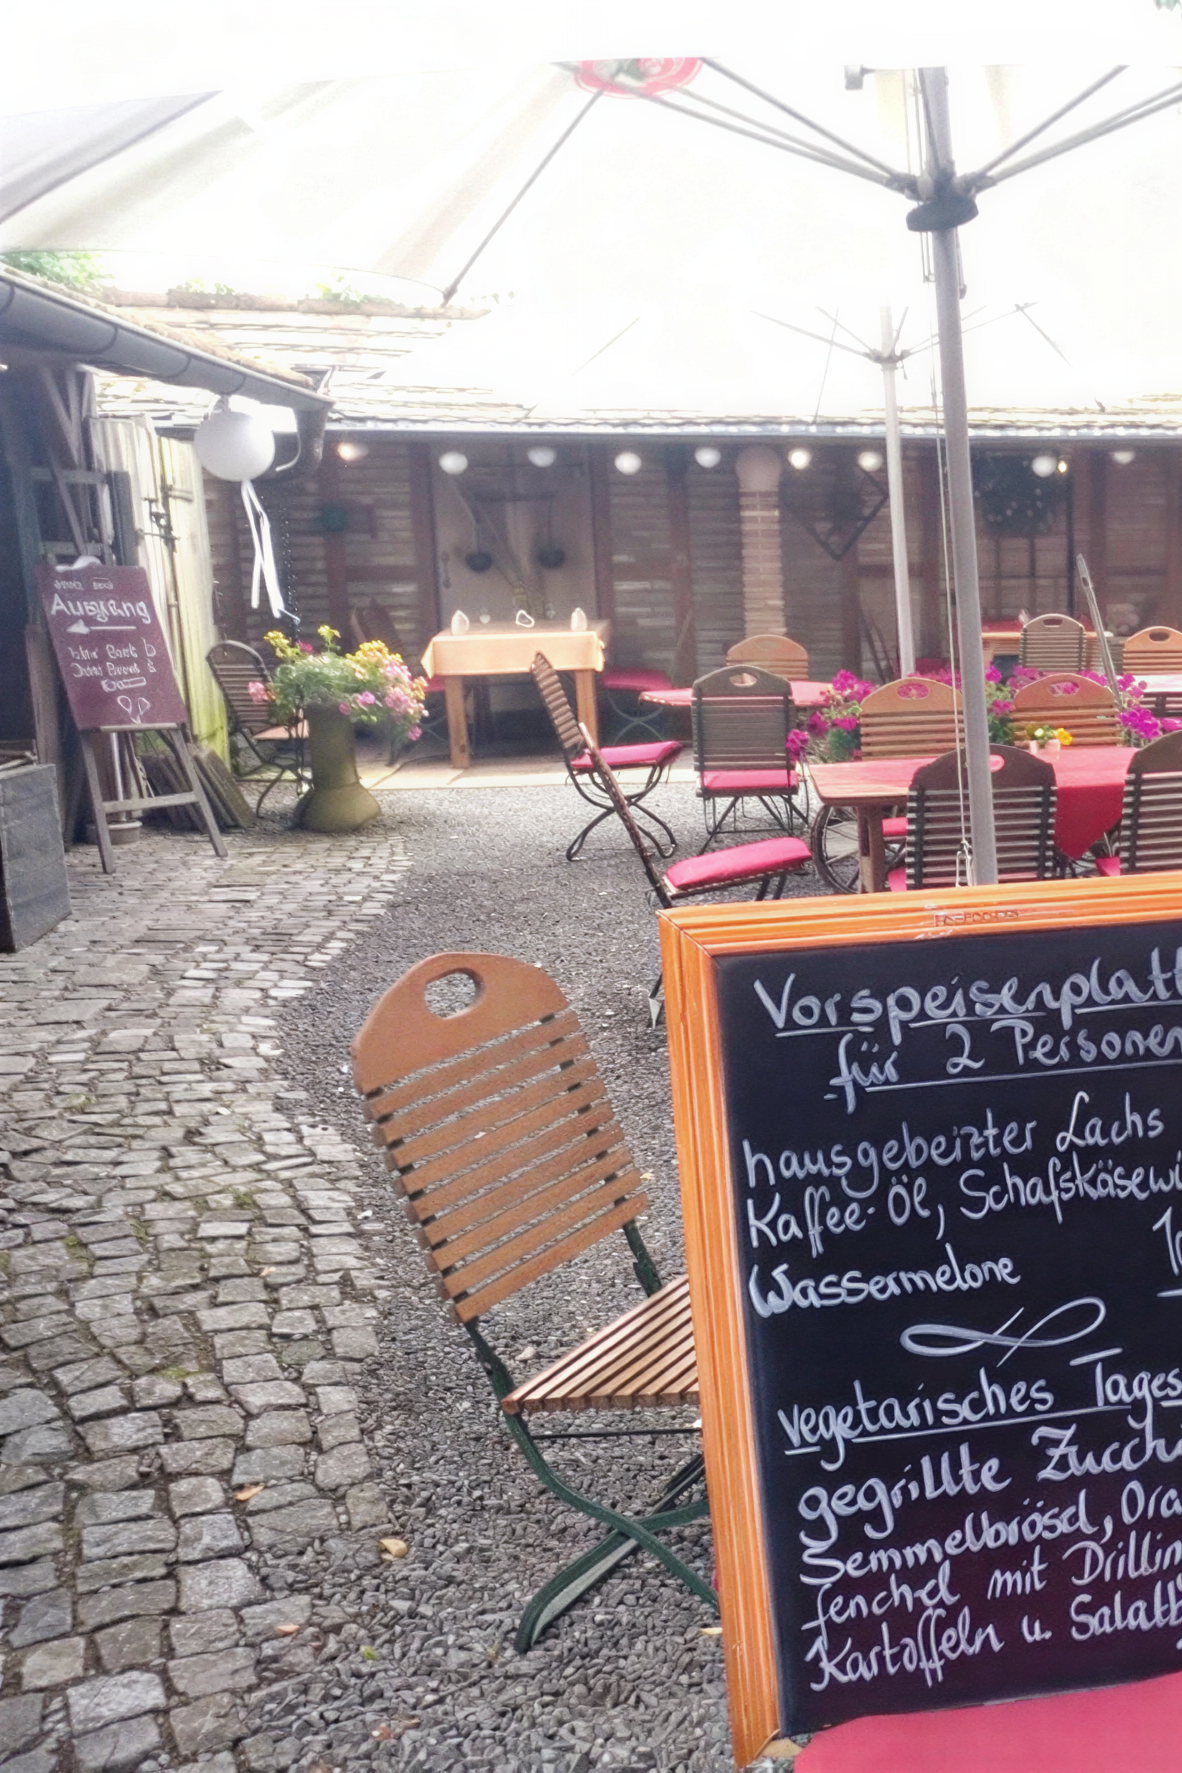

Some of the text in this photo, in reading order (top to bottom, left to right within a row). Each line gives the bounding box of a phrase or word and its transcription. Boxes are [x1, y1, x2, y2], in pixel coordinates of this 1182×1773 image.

[828, 1033, 899, 1114] für
[944, 1024, 985, 1074] 2
[743, 1108, 1037, 1198] hausgebeizter
[1056, 1090, 1165, 1153] Lachs
[749, 1243, 1021, 1318] Wassermelone
[798, 1442, 1012, 1548] gegrillte
[800, 1488, 1113, 1585] Semmelbrösel,
[987, 1545, 1048, 1599] mit
[808, 1606, 1005, 1691] Kartoffeln
